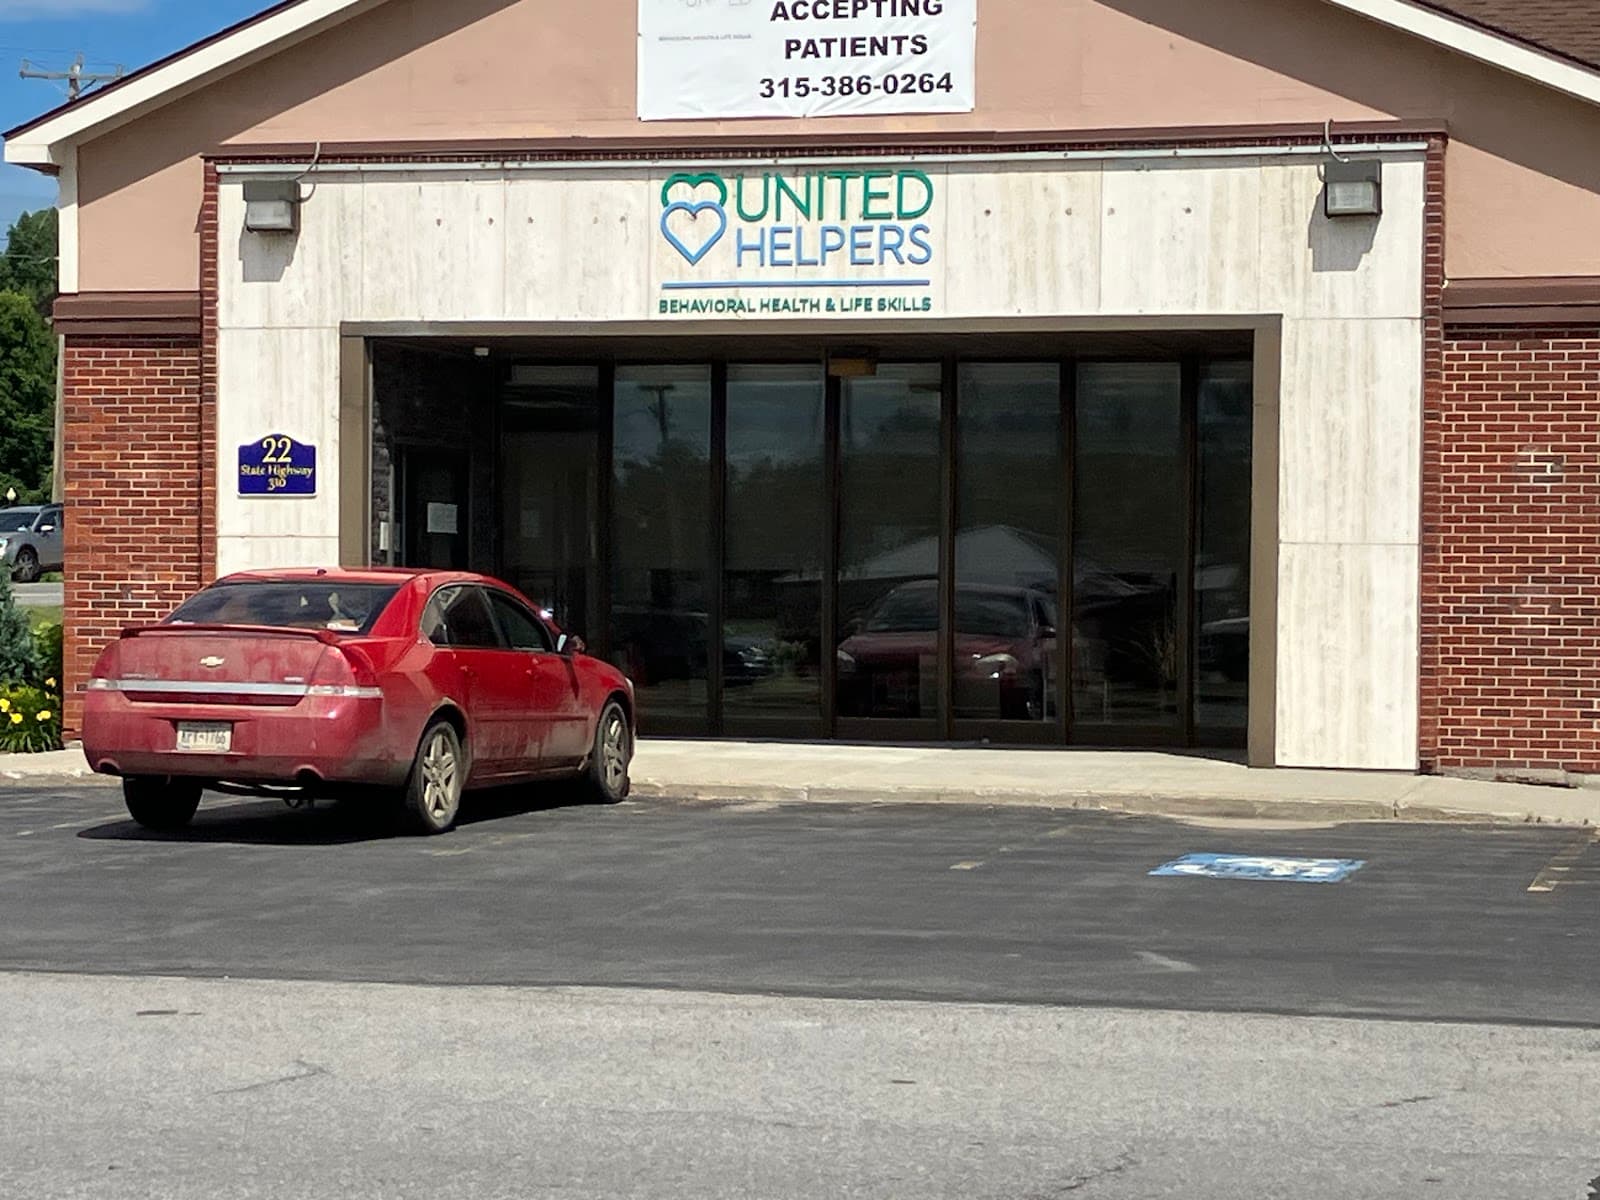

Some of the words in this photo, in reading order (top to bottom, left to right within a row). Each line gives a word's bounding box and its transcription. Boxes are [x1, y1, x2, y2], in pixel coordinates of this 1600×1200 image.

[769, 0, 943, 22] ACCEPTING
[784, 34, 928, 60] PATIENTS
[759, 72, 953, 98] 315-386-0264
[736, 170, 934, 222] UNITED
[736, 223, 933, 267] HELPERS
[659, 298, 755, 314] BEHAVIORAL
[760, 298, 820, 312] HEALTH
[825, 298, 837, 311] &
[840, 297, 873, 311] LIFE
[877, 296, 932, 311] SKILLS
[262, 437, 292, 463] 22
[240, 464, 266, 476] State
[268, 464, 314, 479] Highway
